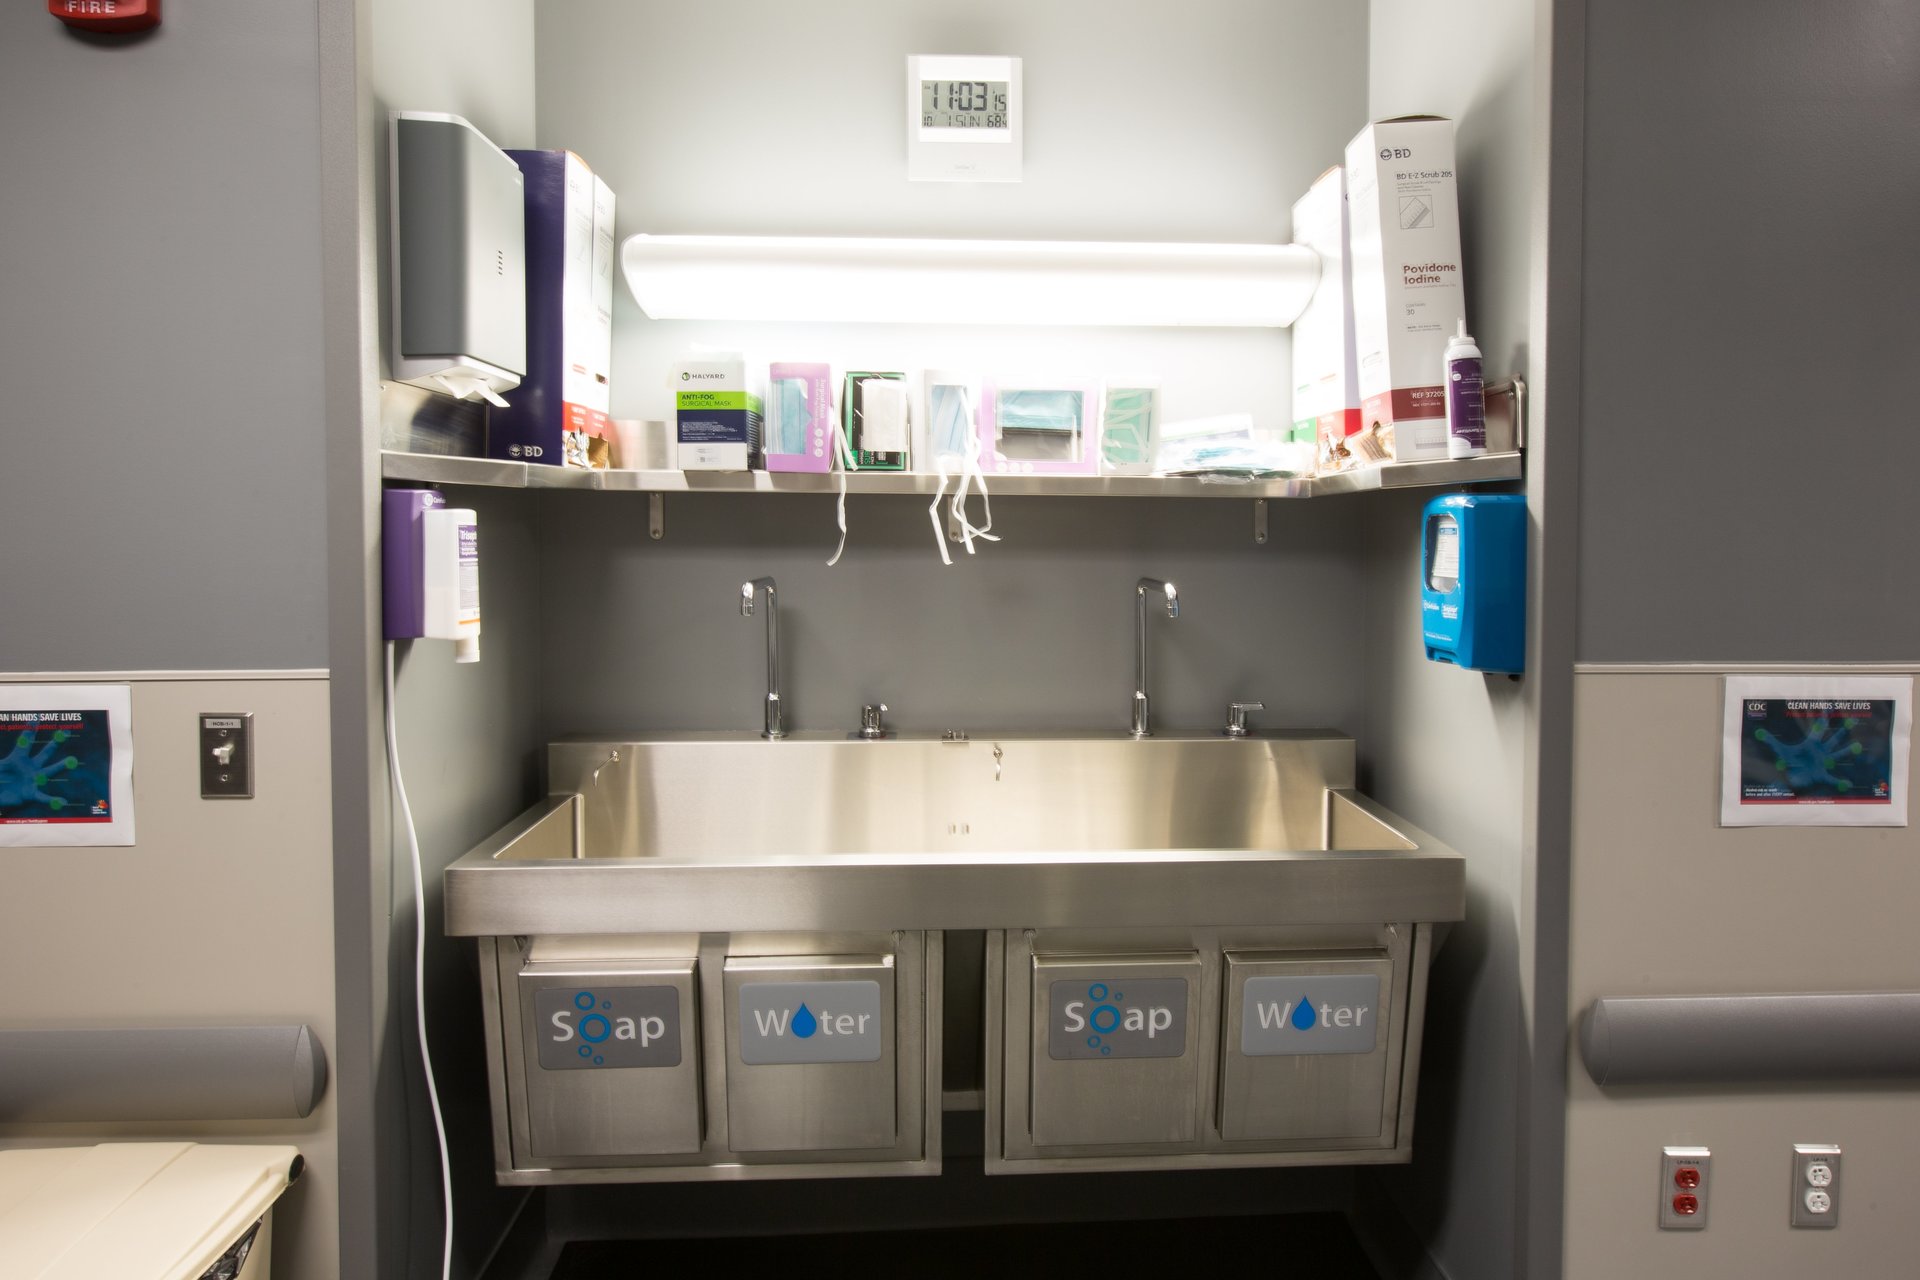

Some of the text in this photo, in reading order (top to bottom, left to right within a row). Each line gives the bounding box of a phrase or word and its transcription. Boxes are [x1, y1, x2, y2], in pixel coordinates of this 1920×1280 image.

[67, 1, 116, 13] FIRE
[933, 82, 988, 111] 11:03
[1394, 148, 1411, 159] BD
[1420, 171, 1440, 179] Scrub
[1440, 170, 1453, 178] 205
[1403, 263, 1457, 274] Povidone
[1404, 274, 1441, 285] Iodine
[1406, 308, 1416, 316] 30
[523, 445, 543, 457] BD
[1748, 702, 1871, 711] CDC CLEAN HANDS SAVE LIVES
[12, 713, 38, 721] HANDS
[40, 713, 60, 721] SAVE
[61, 713, 82, 721] LIVES
[1257, 996, 1368, 1032] Wter
[753, 1003, 871, 1038] Wter
